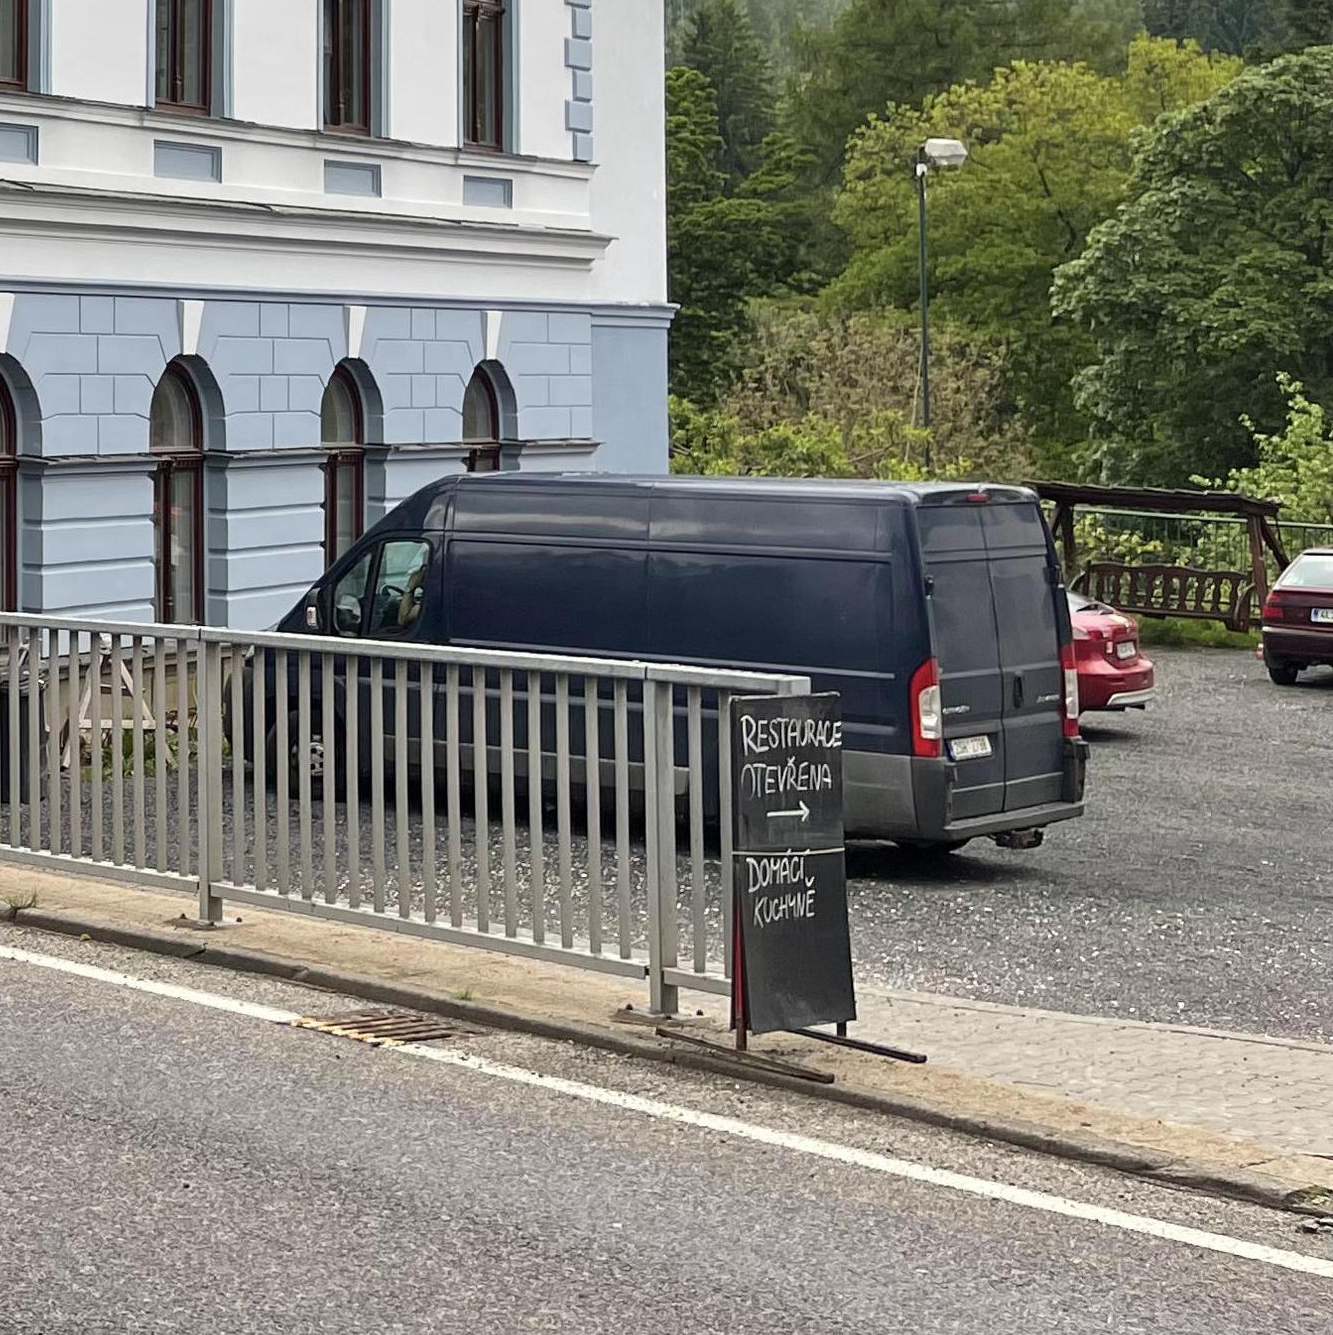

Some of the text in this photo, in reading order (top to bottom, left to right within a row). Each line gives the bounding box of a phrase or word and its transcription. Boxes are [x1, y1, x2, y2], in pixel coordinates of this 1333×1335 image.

[741, 715, 842, 756] RESTAURACE
[740, 756, 832, 801] OTEVŘENA
[746, 849, 810, 893] DOMÁCÍ
[753, 876, 816, 928] KUCHYNĚ
